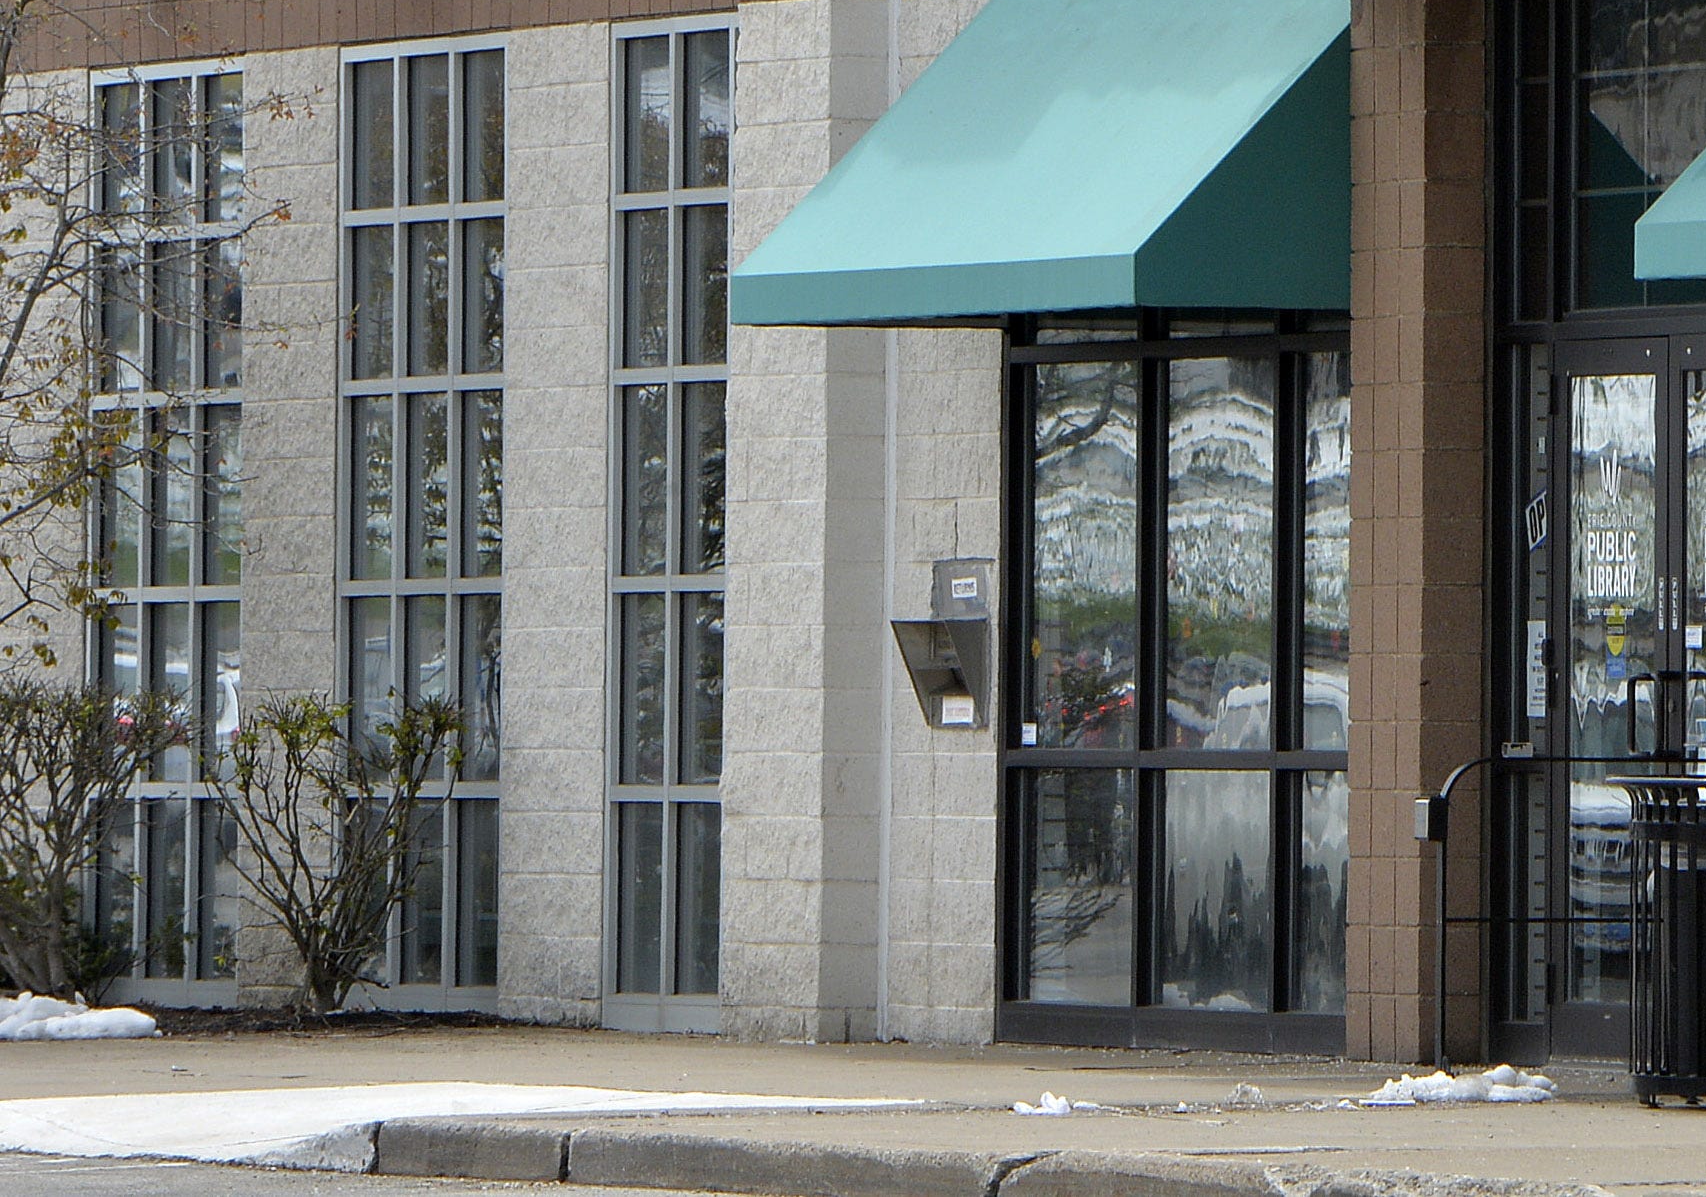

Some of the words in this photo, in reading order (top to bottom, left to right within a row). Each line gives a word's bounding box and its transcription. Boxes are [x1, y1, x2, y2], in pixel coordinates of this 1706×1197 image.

[1587, 513, 1604, 528] ERIE
[1607, 513, 1636, 528] COUNTY
[1587, 531, 1636, 562] PUBLIC
[1587, 565, 1636, 597] LIBRARY
